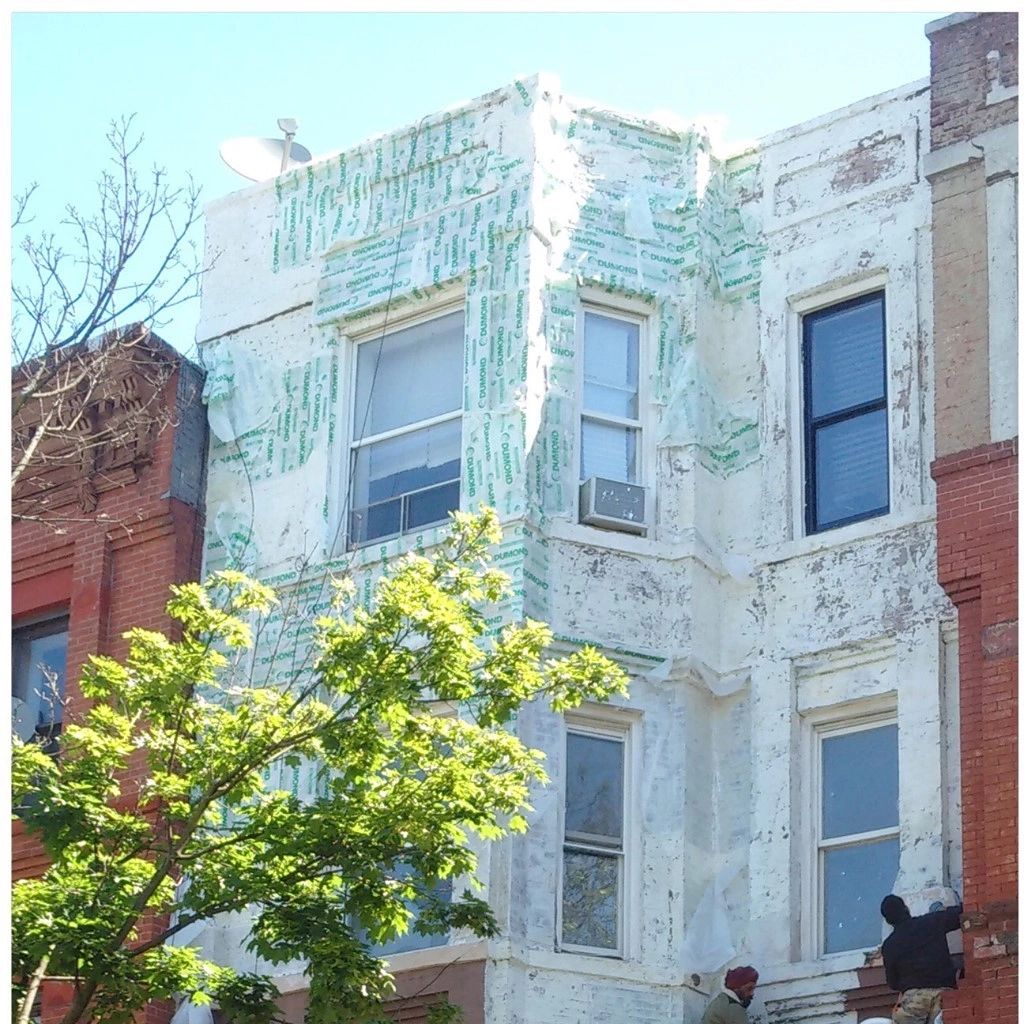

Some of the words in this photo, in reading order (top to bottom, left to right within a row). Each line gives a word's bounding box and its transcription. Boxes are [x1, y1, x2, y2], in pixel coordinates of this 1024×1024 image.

[352, 240, 387, 257] DUMOND
[597, 260, 638, 275] DUMOND
[650, 254, 685, 265] DUMOND
[368, 281, 402, 297] DUMOND
[480, 296, 488, 336] DUMOND
[516, 290, 525, 328] DUMOND
[302, 371, 311, 410] DUMOND
[331, 364, 339, 403] DUMOND
[312, 393, 321, 432] DUMOND
[502, 443, 512, 485] DUMOND
[552, 430, 560, 471] DUMOND
[467, 457, 475, 497] DUMOND
[494, 547, 528, 561] DUMOND
